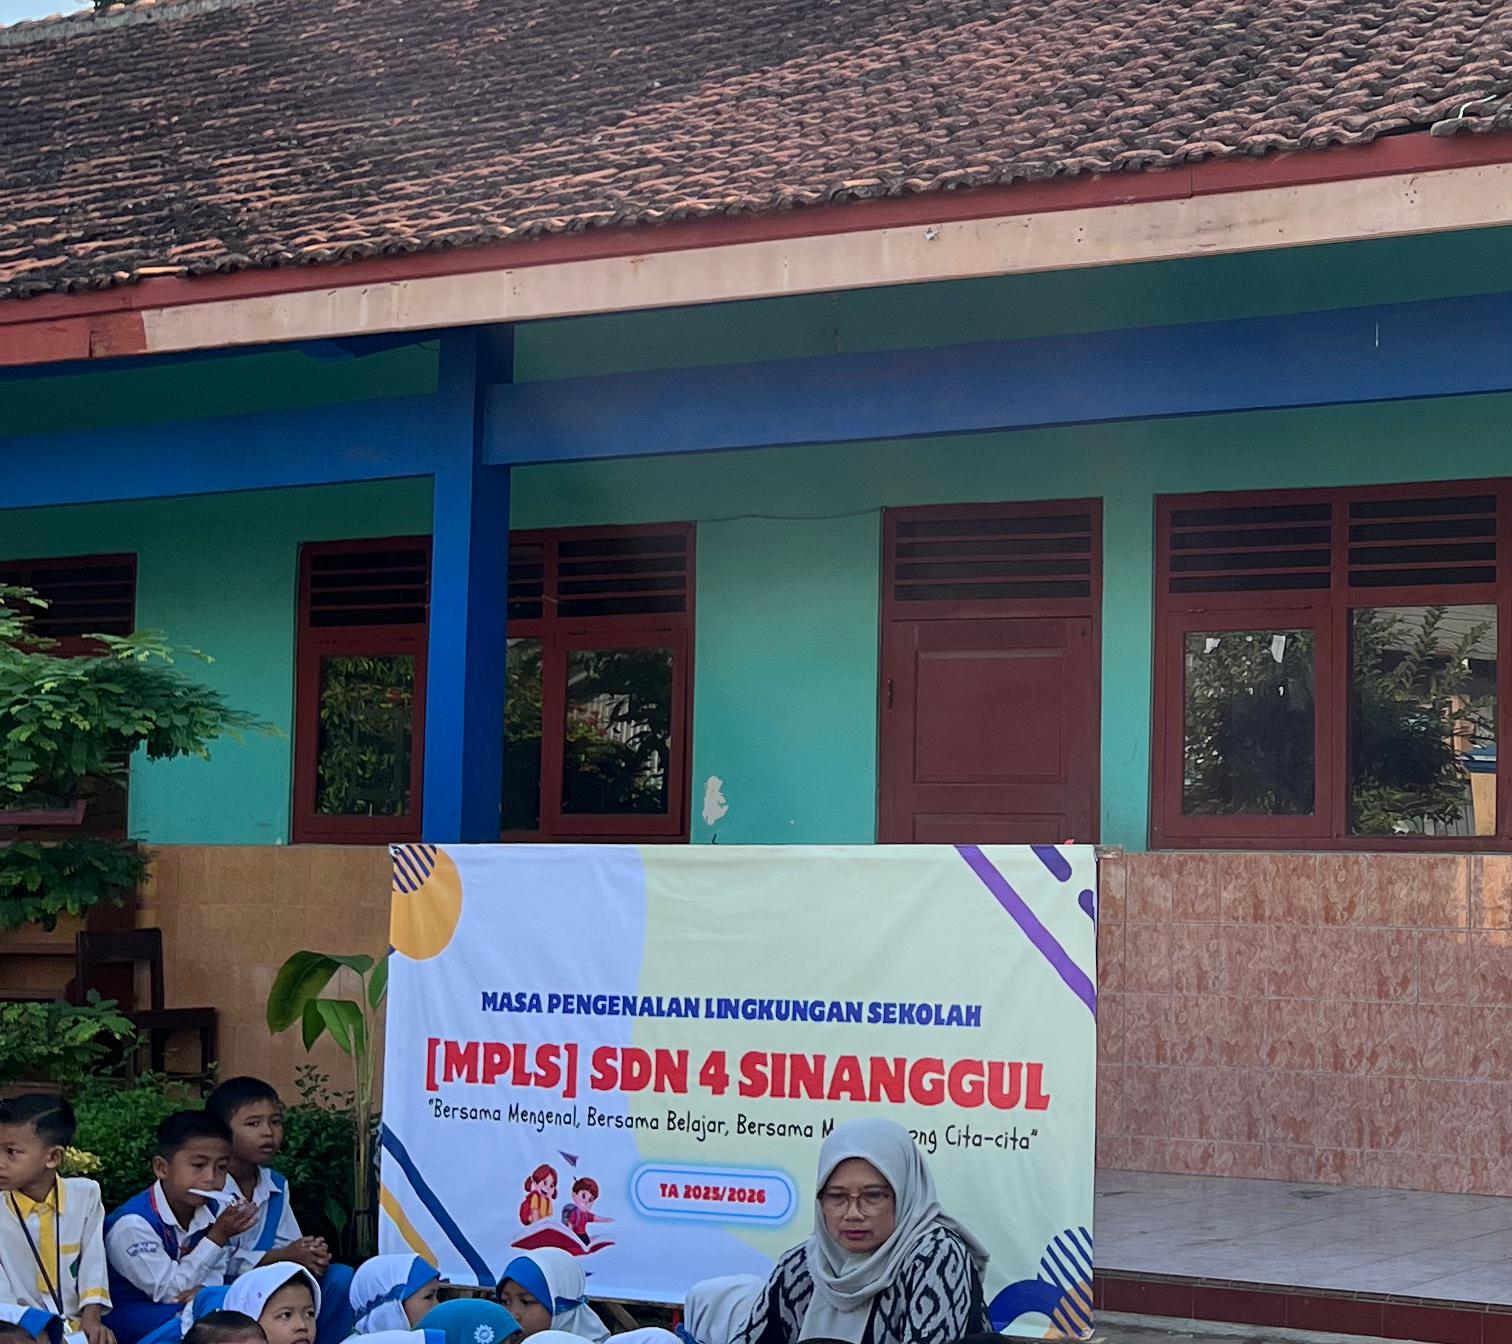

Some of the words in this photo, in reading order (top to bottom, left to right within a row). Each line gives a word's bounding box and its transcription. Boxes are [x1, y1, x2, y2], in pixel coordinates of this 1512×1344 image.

[481, 991, 543, 1013] MASA
[547, 993, 700, 1018] PENGENALAN
[704, 997, 863, 1023] LINGKUNGAN
[867, 1001, 982, 1027] SEKOLAH
[425, 1037, 578, 1098] [MPLS]
[590, 1046, 689, 1094] SDN
[699, 1050, 730, 1095] 4
[738, 1051, 1050, 1110] SINANGGUL
[508, 1102, 580, 1133] Mengenal,
[587, 1106, 659, 1131] Bersama
[666, 1110, 730, 1142] Belajar,
[736, 1114, 813, 1138] Bersama
[659, 1183, 679, 1199] TA
[683, 1184, 766, 1204] 2025/2026
